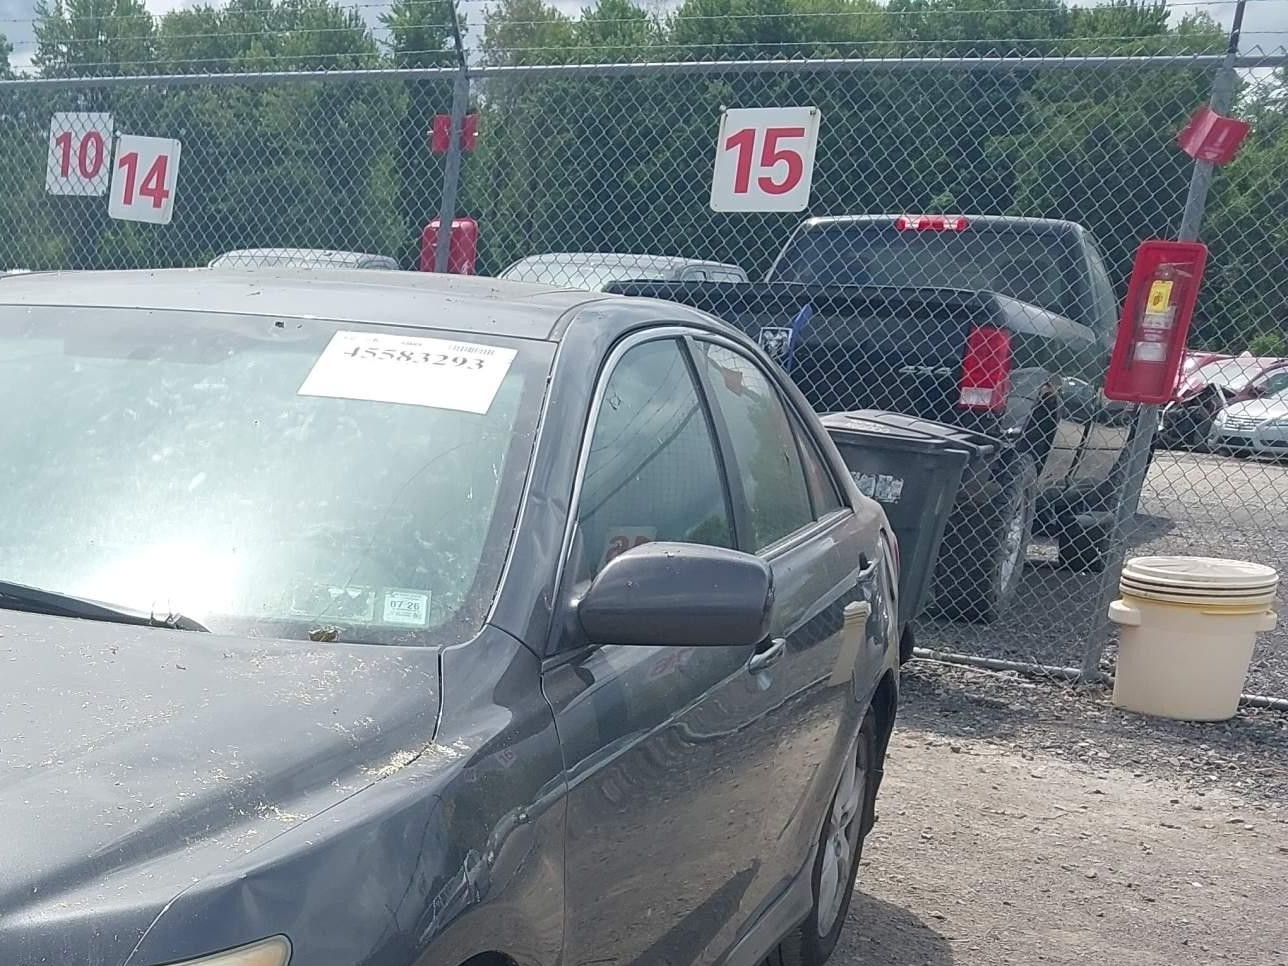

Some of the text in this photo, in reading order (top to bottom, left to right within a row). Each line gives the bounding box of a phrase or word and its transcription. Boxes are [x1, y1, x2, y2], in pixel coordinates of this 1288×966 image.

[55, 131, 105, 179] 10
[118, 151, 170, 208] 14
[724, 127, 806, 195] 15
[343, 345, 485, 370] 45583293
